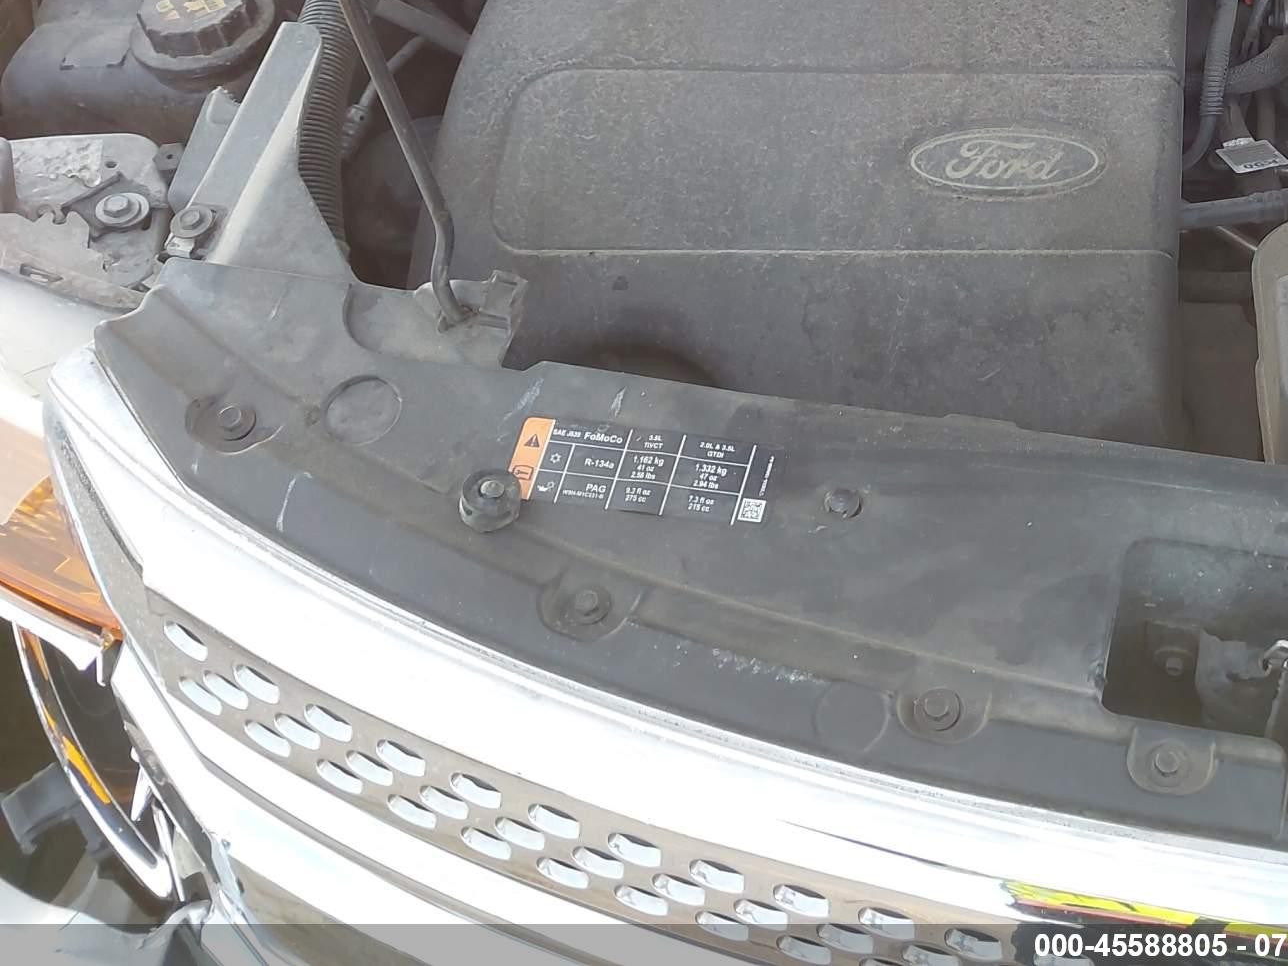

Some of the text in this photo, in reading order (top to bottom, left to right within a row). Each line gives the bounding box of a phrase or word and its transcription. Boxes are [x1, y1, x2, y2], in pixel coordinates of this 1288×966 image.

[945, 140, 1064, 180] Ford
[583, 431, 623, 444] FoMoCo
[584, 457, 615, 469] R-134a
[653, 455, 665, 467] kg
[695, 463, 727, 477] 1.332 kg
[585, 483, 607, 493] PAG
